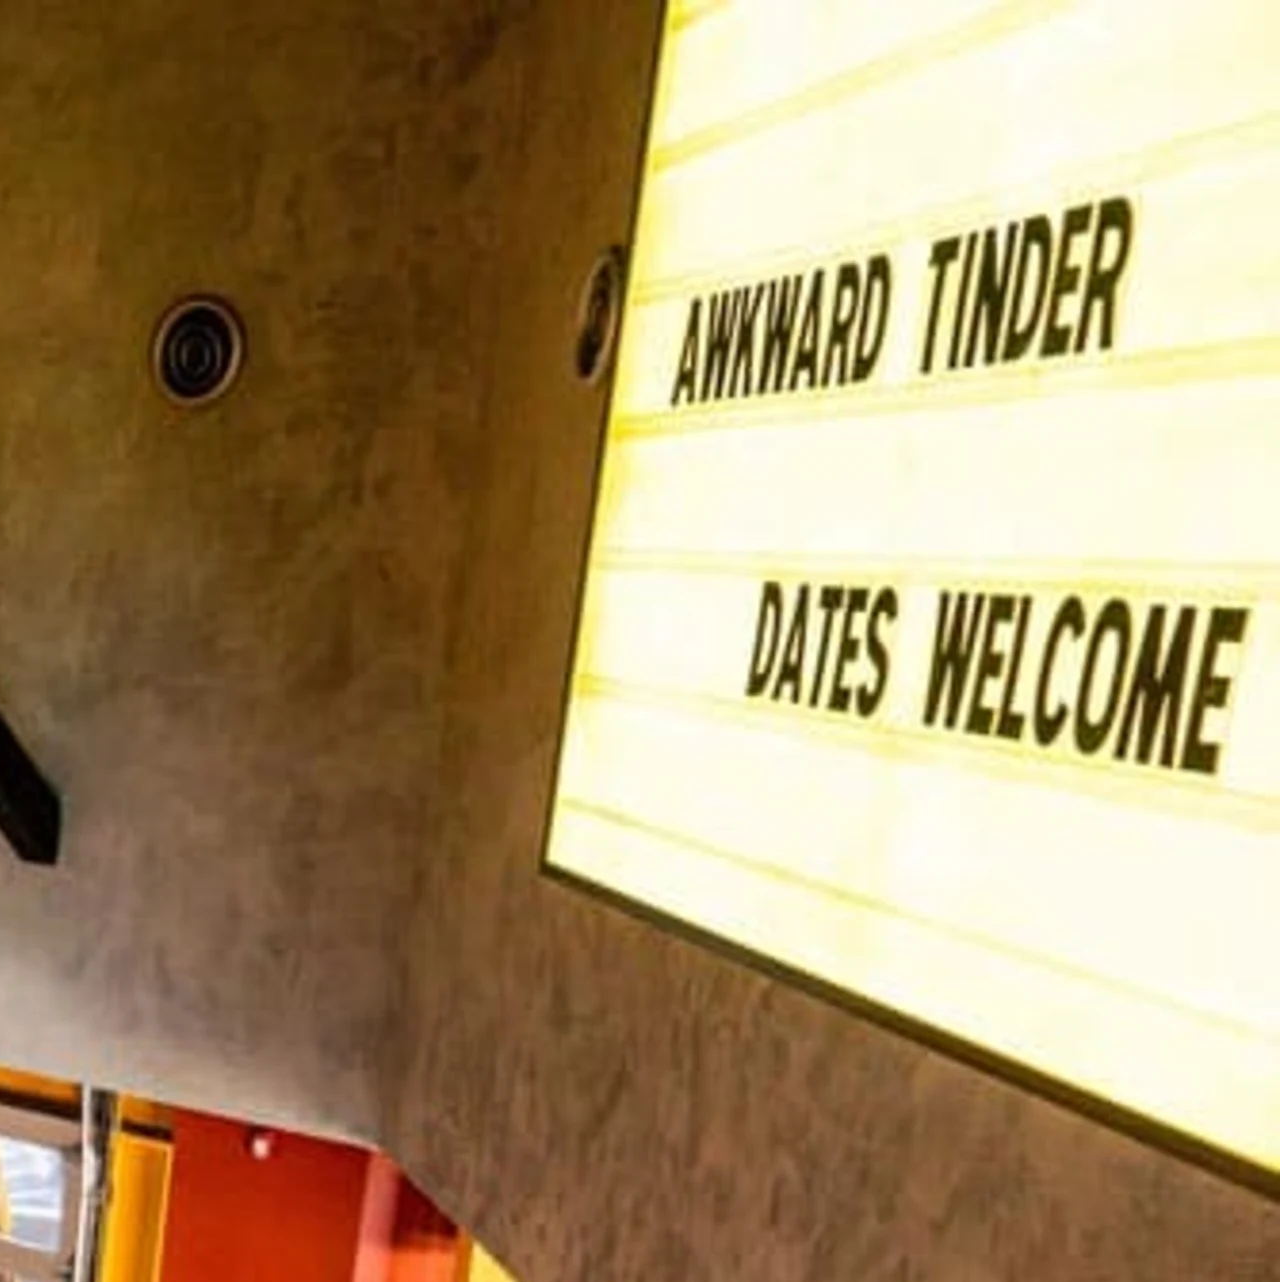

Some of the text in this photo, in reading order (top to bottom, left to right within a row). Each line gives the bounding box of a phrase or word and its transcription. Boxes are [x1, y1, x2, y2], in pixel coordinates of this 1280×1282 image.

[670, 196, 1133, 406] AWKWARD TINDER
[746, 581, 1250, 775] DATES WELCOME
